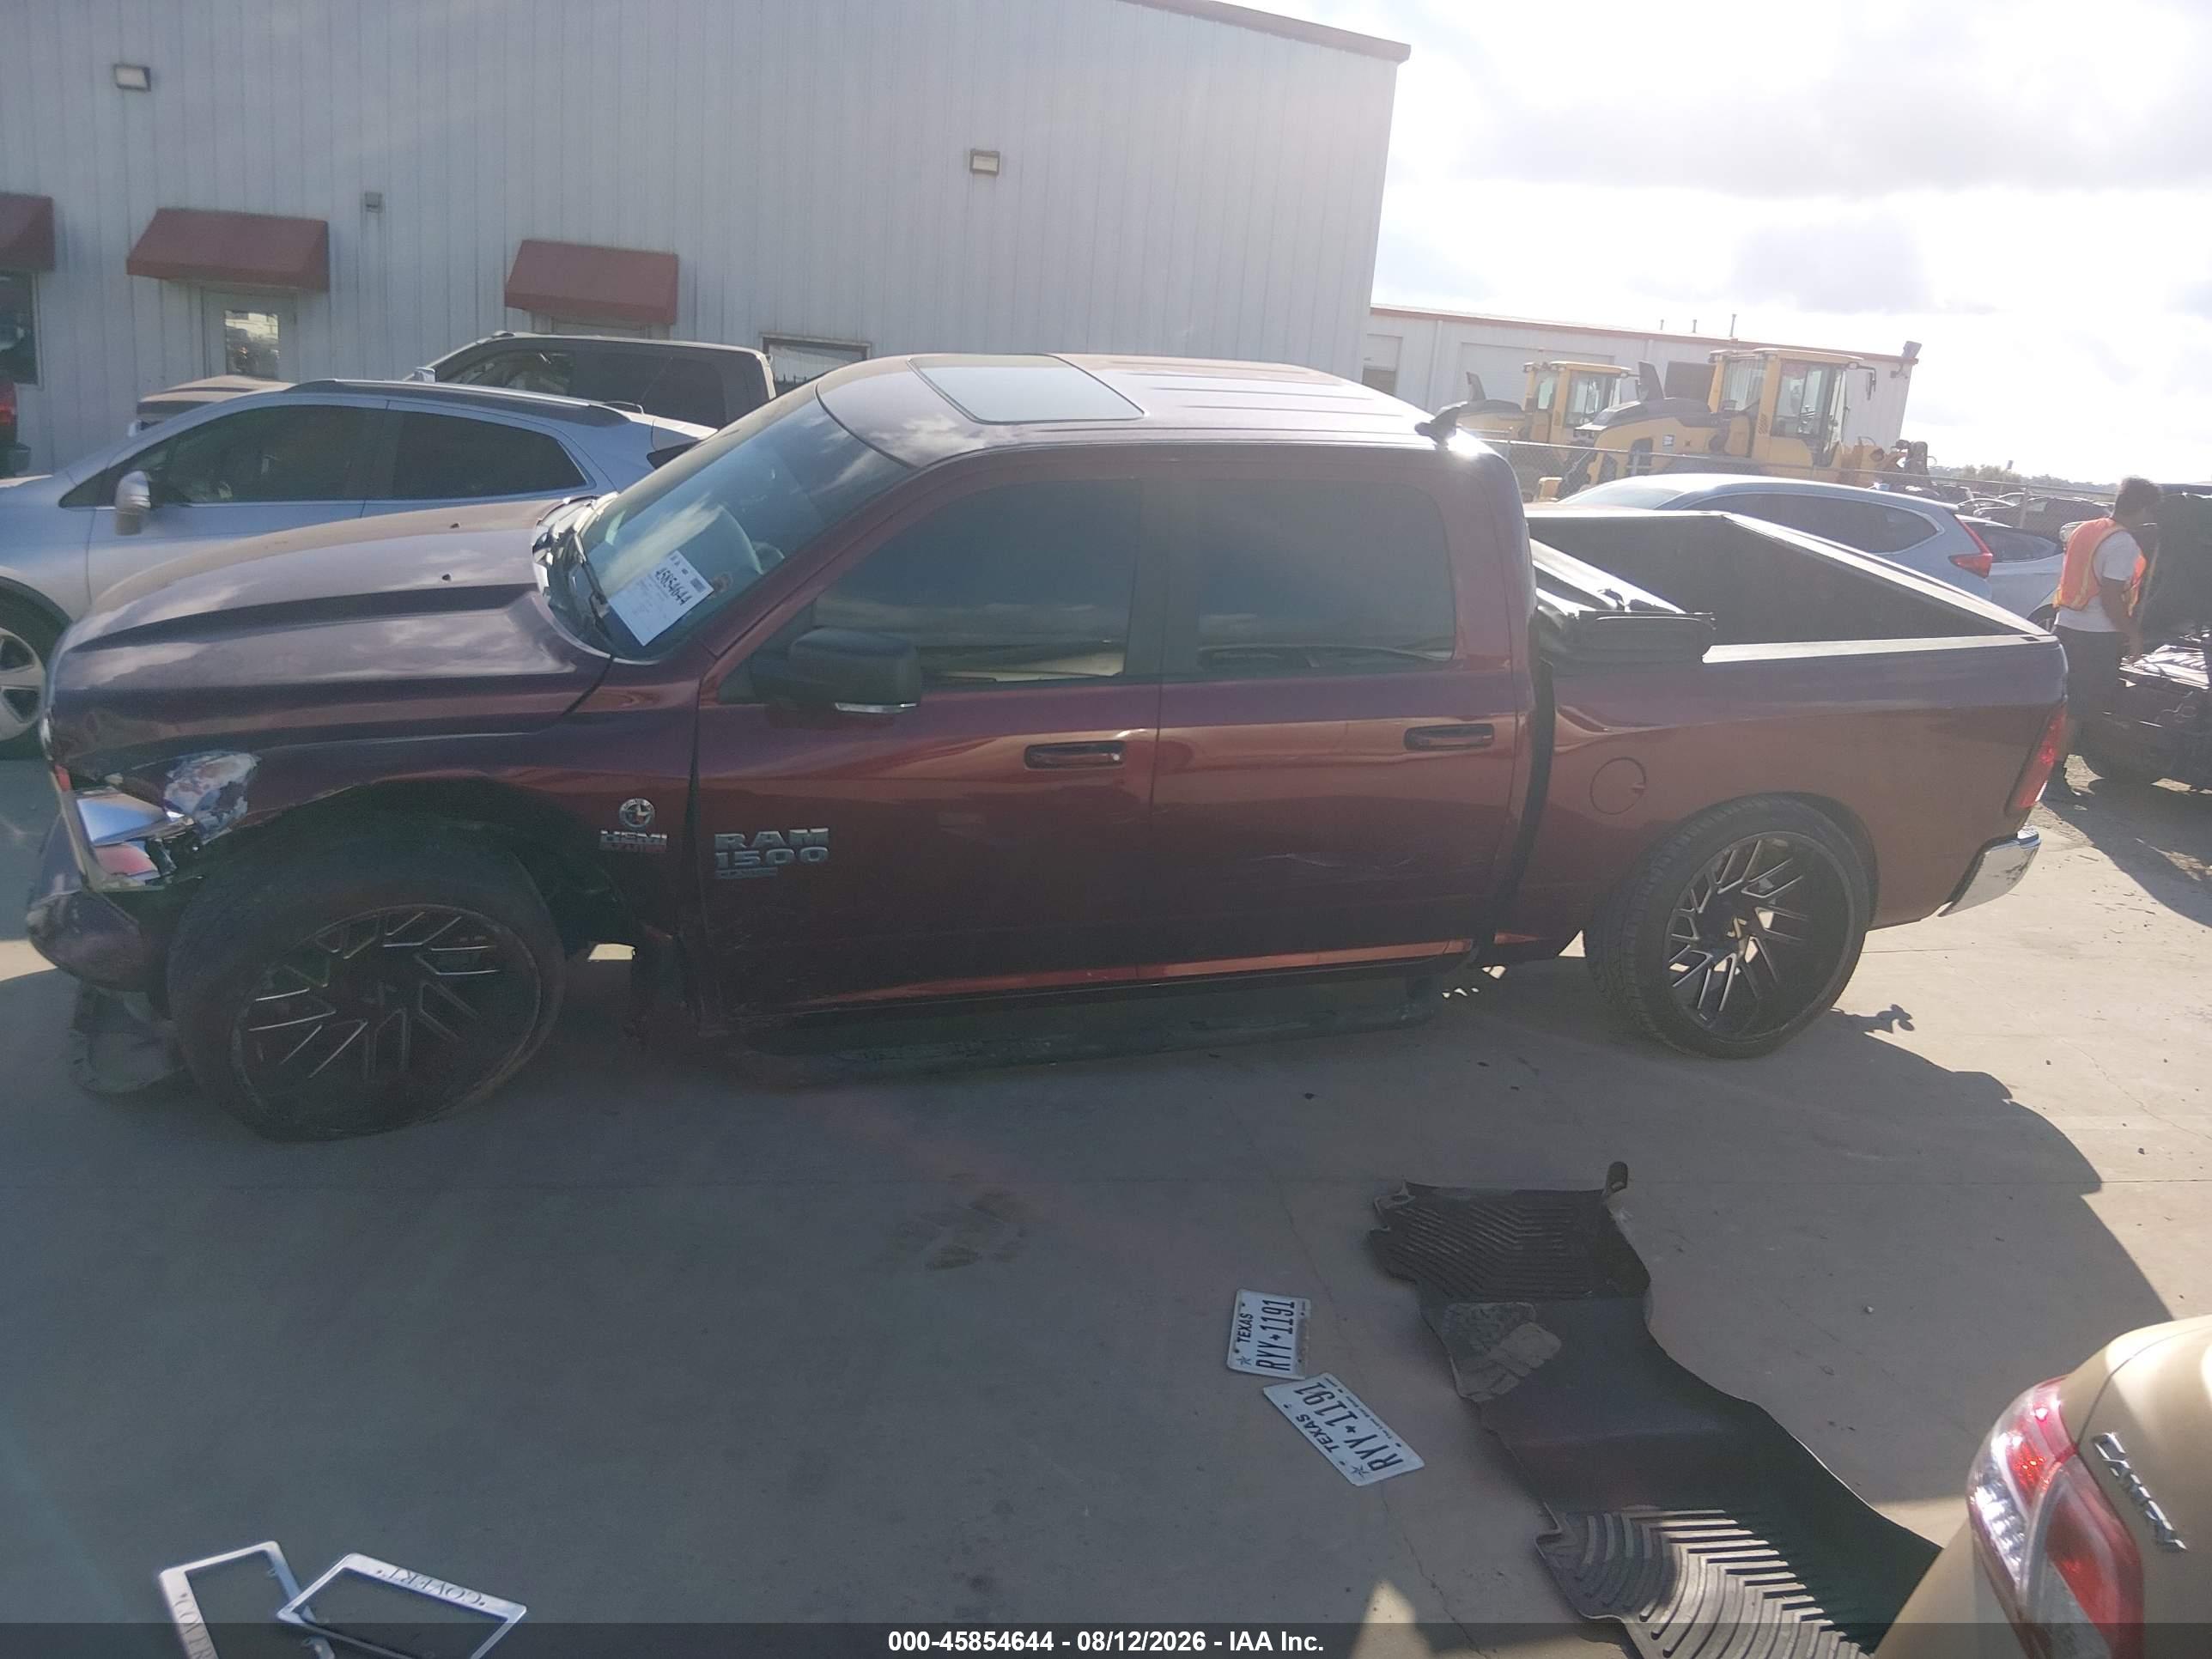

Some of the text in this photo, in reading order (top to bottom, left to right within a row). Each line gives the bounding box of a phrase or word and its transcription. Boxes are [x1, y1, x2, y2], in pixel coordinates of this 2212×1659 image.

[654, 567, 693, 606] 45854644
[714, 828, 830, 850] RAM
[714, 846, 830, 869] 1500
[1237, 1312, 1255, 1344] TEXAS
[1296, 1413, 1340, 1454] TEXAS
